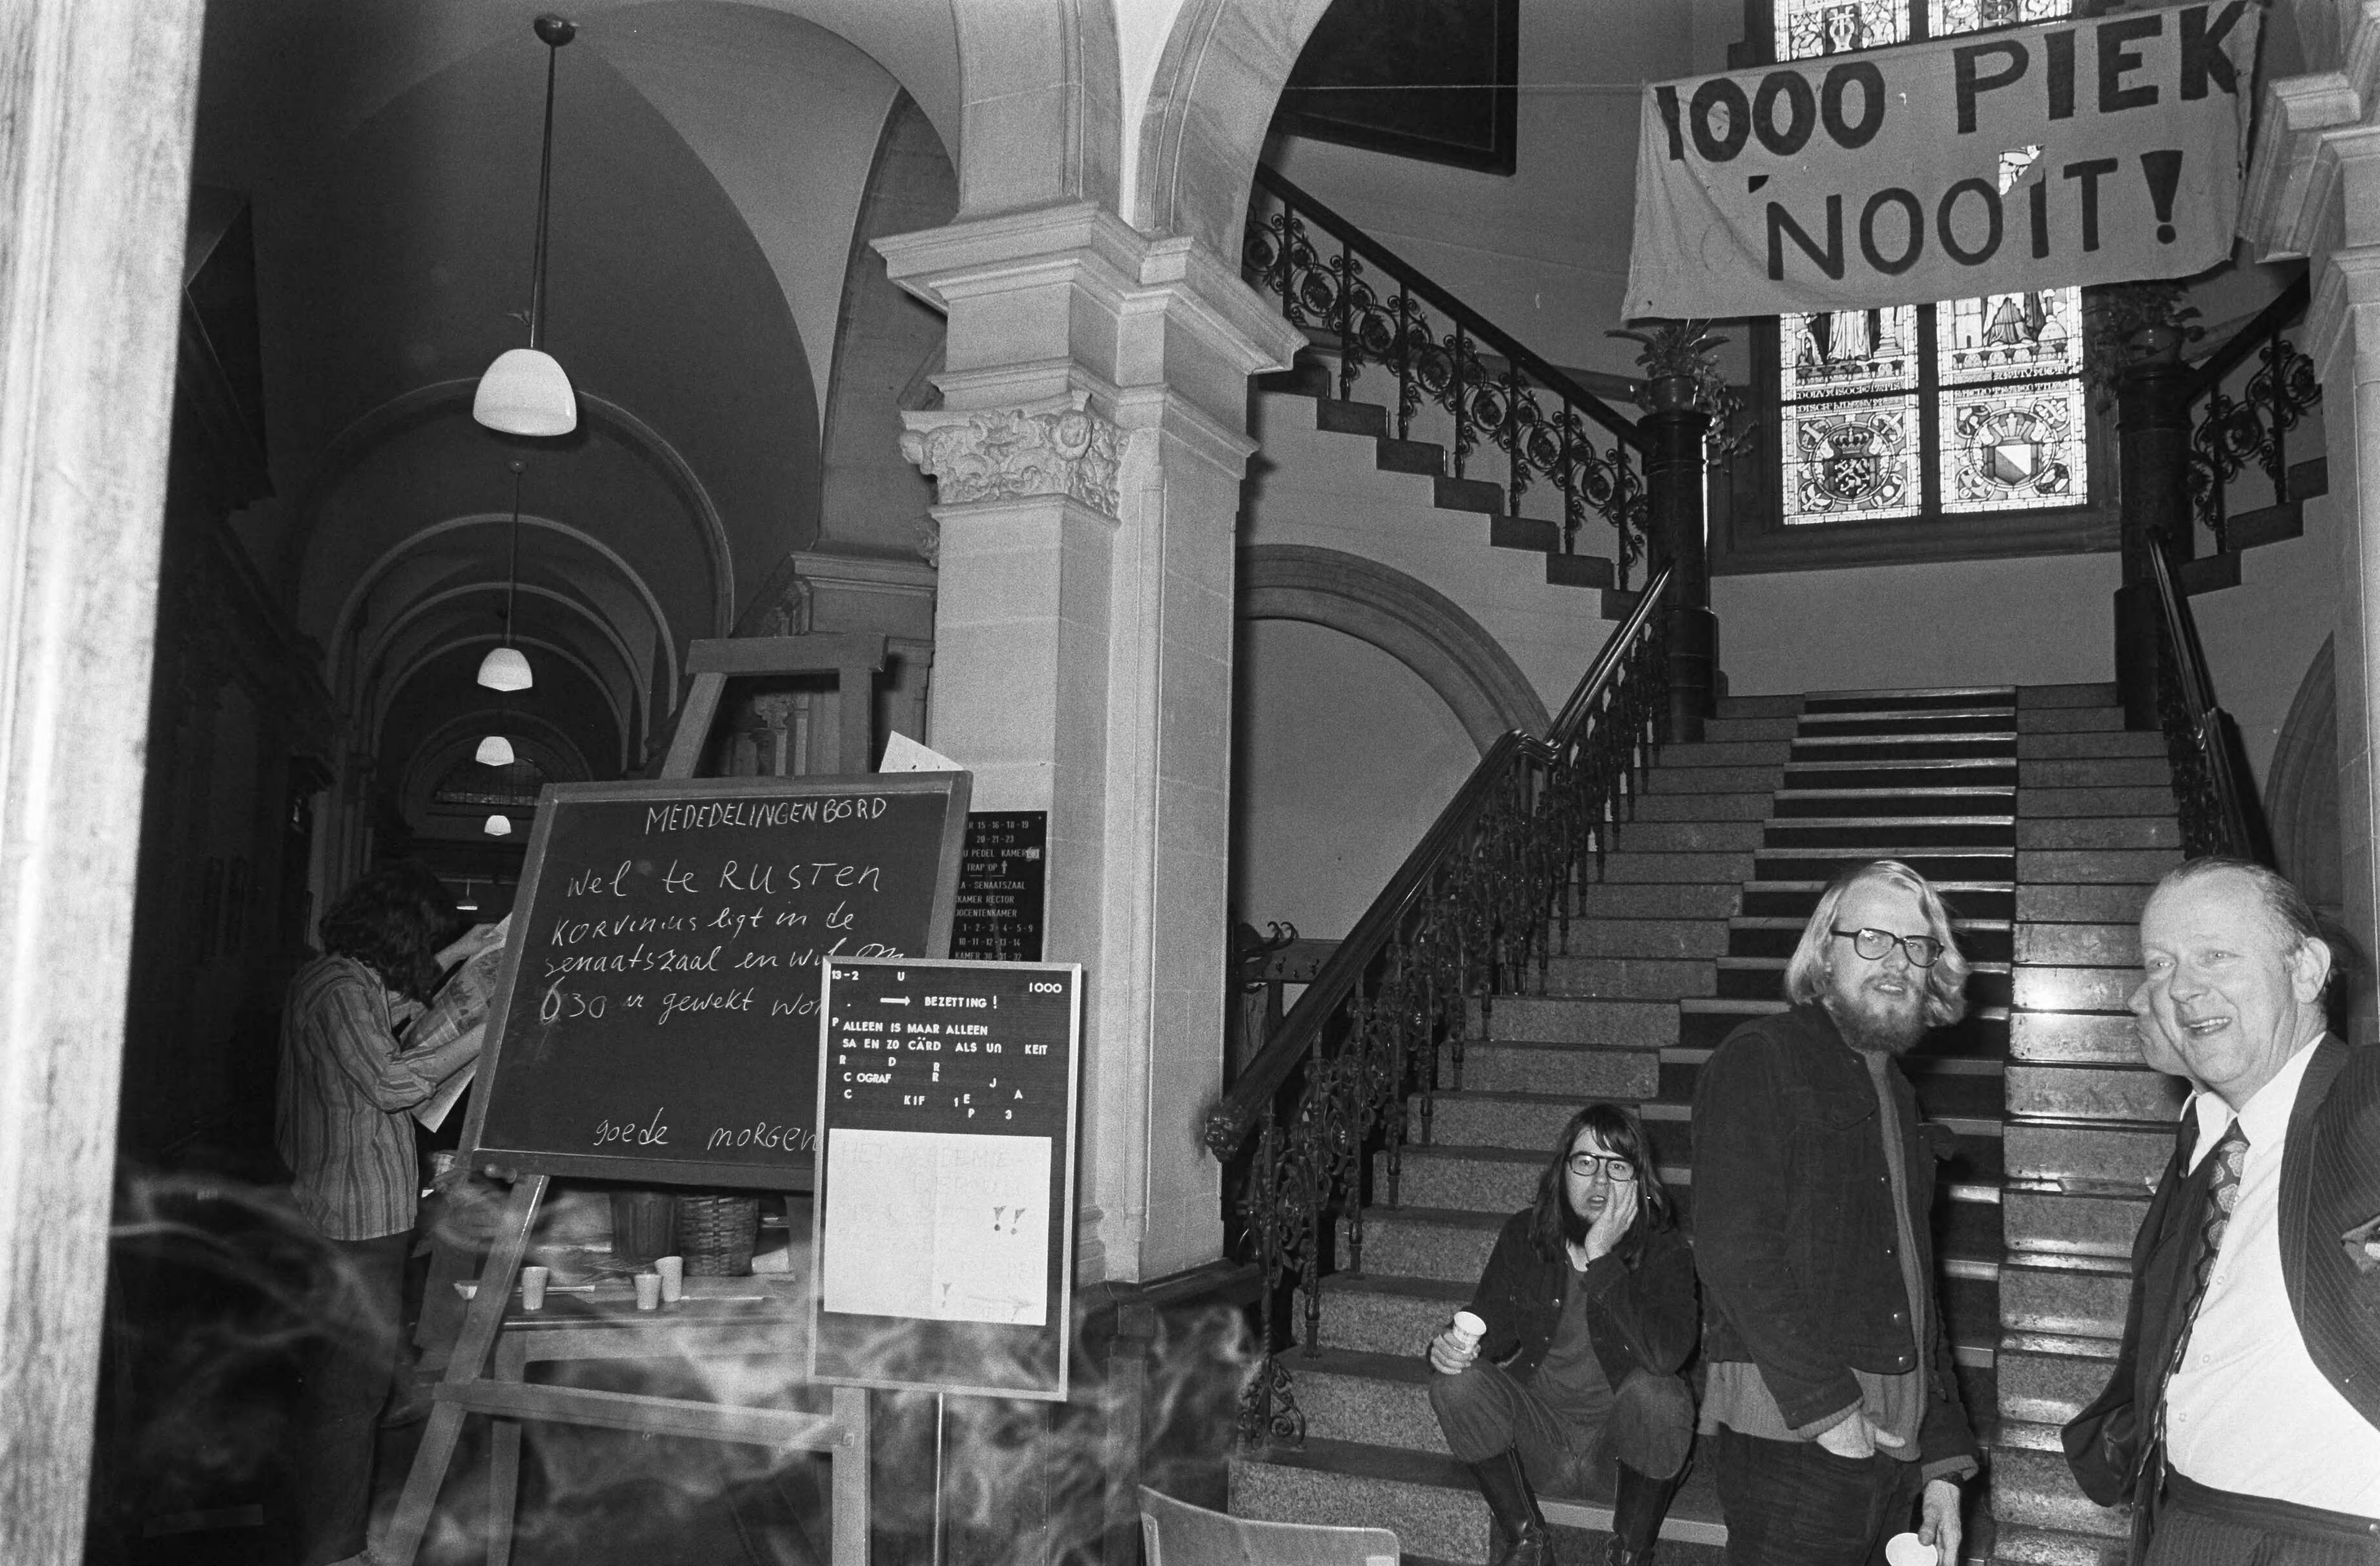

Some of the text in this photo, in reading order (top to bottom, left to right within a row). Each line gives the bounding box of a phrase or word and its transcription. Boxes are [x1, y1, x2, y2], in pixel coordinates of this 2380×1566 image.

[1655, 0, 2246, 162] 1000 PIEK
[646, 798, 886, 834] MEDEDELINGENBORD
[1021, 820, 1029, 829] 19
[1005, 835, 1014, 843] 23
[971, 849, 994, 857] PEDEL
[1001, 849, 1027, 857] KAMER
[967, 863, 998, 871] TRAP OP
[662, 859, 699, 893] te
[974, 881, 1025, 890] SENAATSZAAL
[986, 895, 1014, 904] RECTOR
[708, 906, 764, 939] ligt
[826, 900, 854, 930] de
[989, 924, 994, 932] 3
[959, 937, 966, 946] 10
[1000, 938, 1006, 946] 13
[1014, 938, 1020, 946] 14
[545, 943, 722, 977] senaatszaal
[735, 952, 778, 968] en
[897, 971, 905, 981] U
[1029, 982, 1063, 993] 1000
[658, 987, 755, 1025] gewekt
[832, 1017, 839, 1027] P
[843, 1021, 988, 1036] ALLEEN IS MAAR ALLEEN
[843, 1038, 857, 1048] SA
[864, 1038, 879, 1049] EN
[887, 1039, 899, 1050] ZO
[955, 1042, 977, 1052] ALS
[1025, 1044, 1048, 1055] KEIT
[839, 1054, 846, 1064] R
[888, 1056, 897, 1066] D
[933, 1062, 940, 1072] R
[843, 1072, 892, 1084] C OGRAF
[932, 1072, 939, 1082] R
[989, 1077, 997, 1088] J
[843, 1088, 852, 1099] C
[963, 1093, 970, 1104] E
[1014, 1088, 1023, 1099] A
[968, 1108, 976, 1118] P
[1005, 1109, 1012, 1120] 3
[593, 1106, 669, 1146] goede
